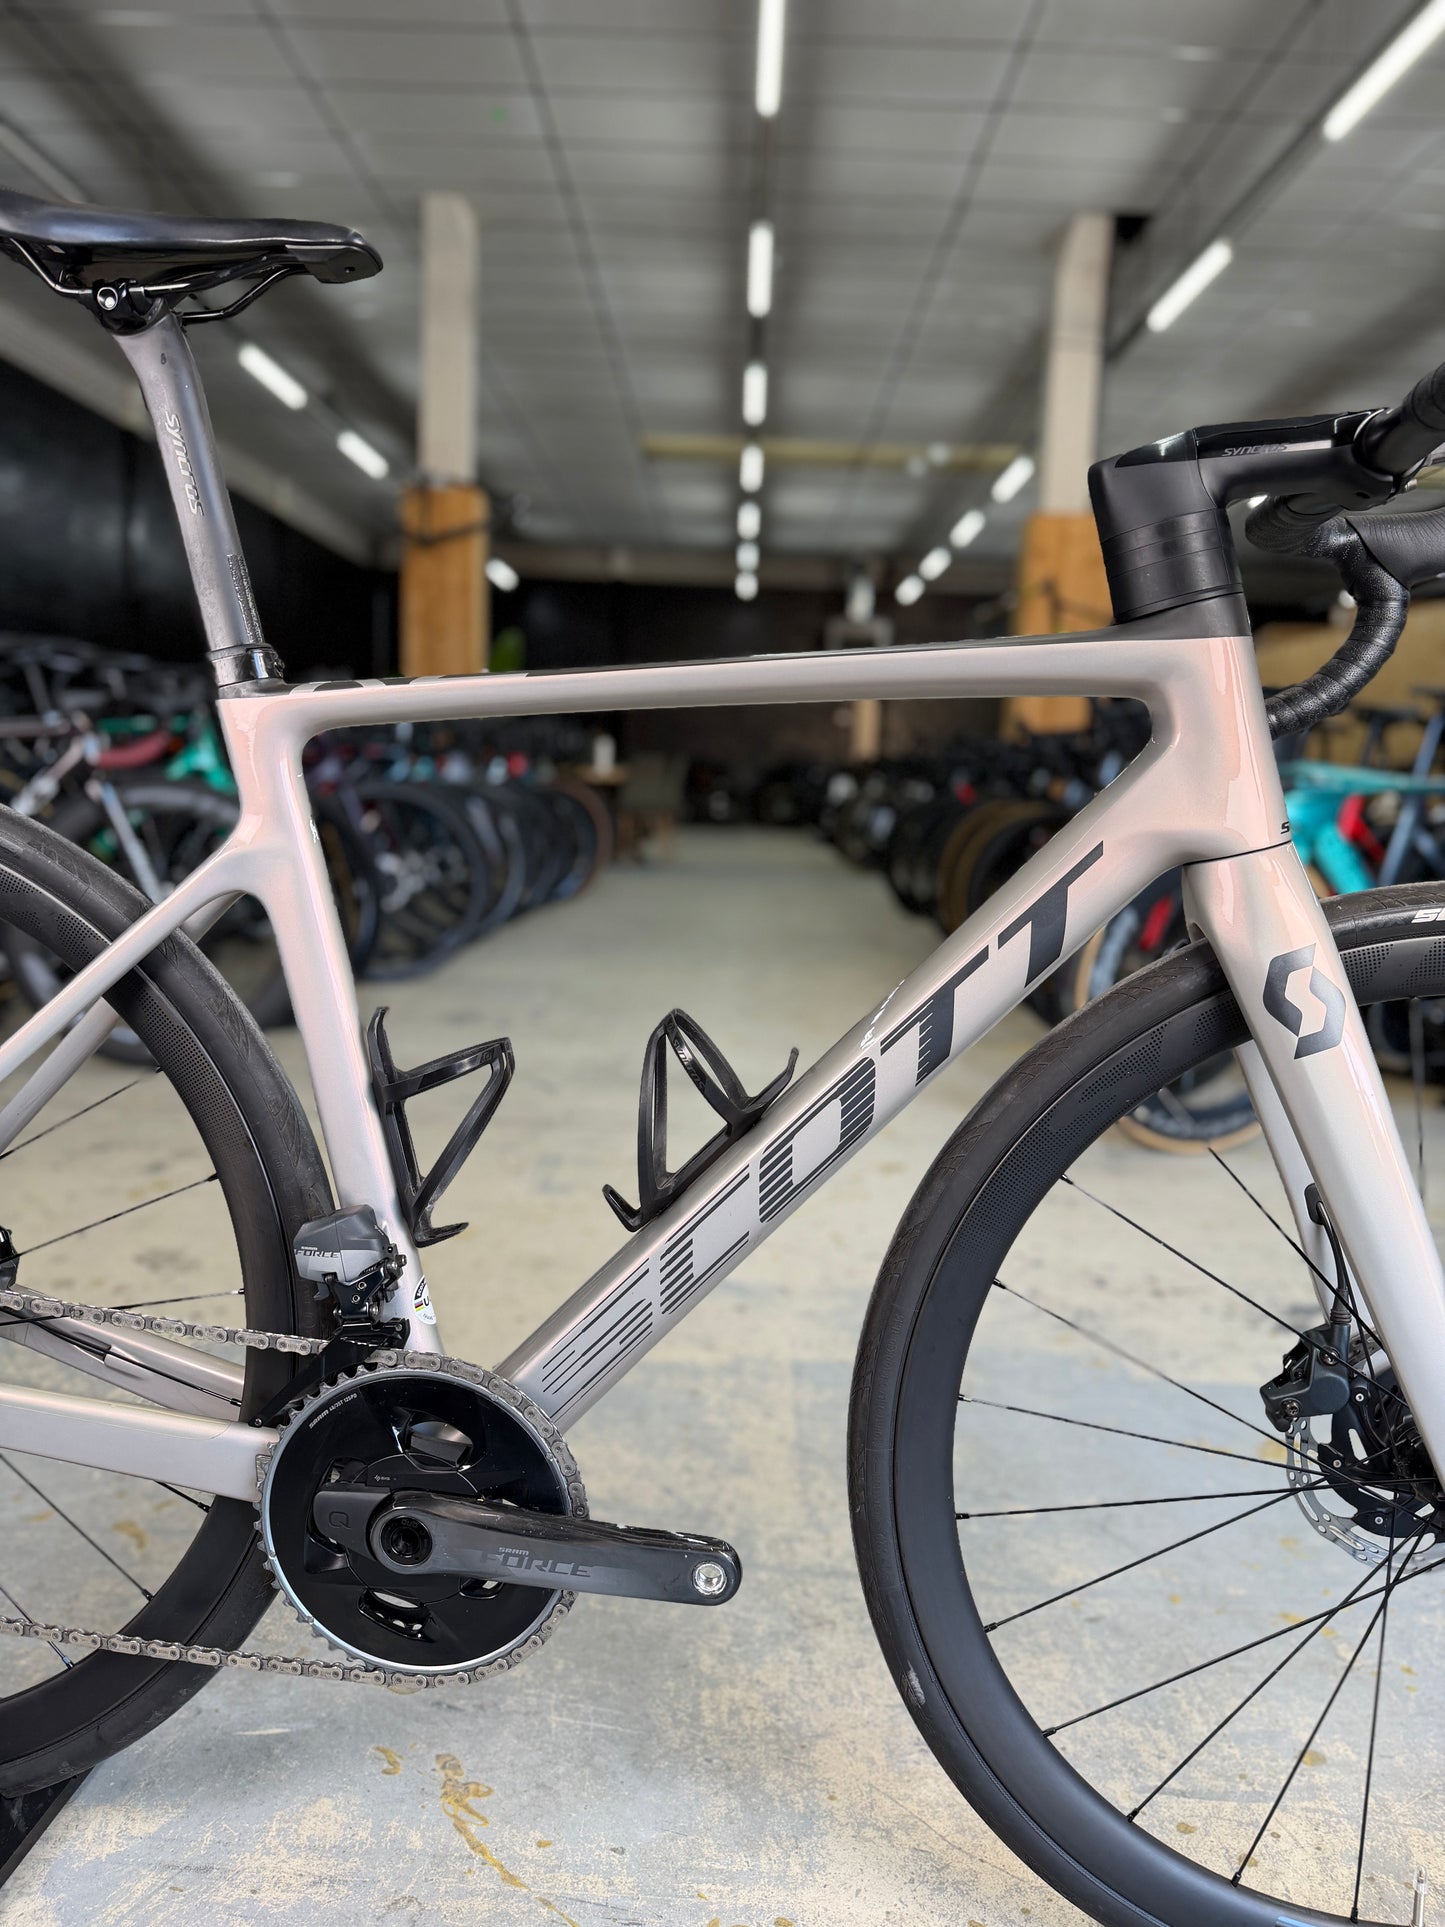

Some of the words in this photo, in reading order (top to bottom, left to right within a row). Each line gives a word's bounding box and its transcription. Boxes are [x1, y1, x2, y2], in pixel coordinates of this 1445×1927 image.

[541, 840, 1103, 1419] SCOTT
[481, 1550, 591, 1578] FORCE
[498, 1547, 529, 1556] SRAM
